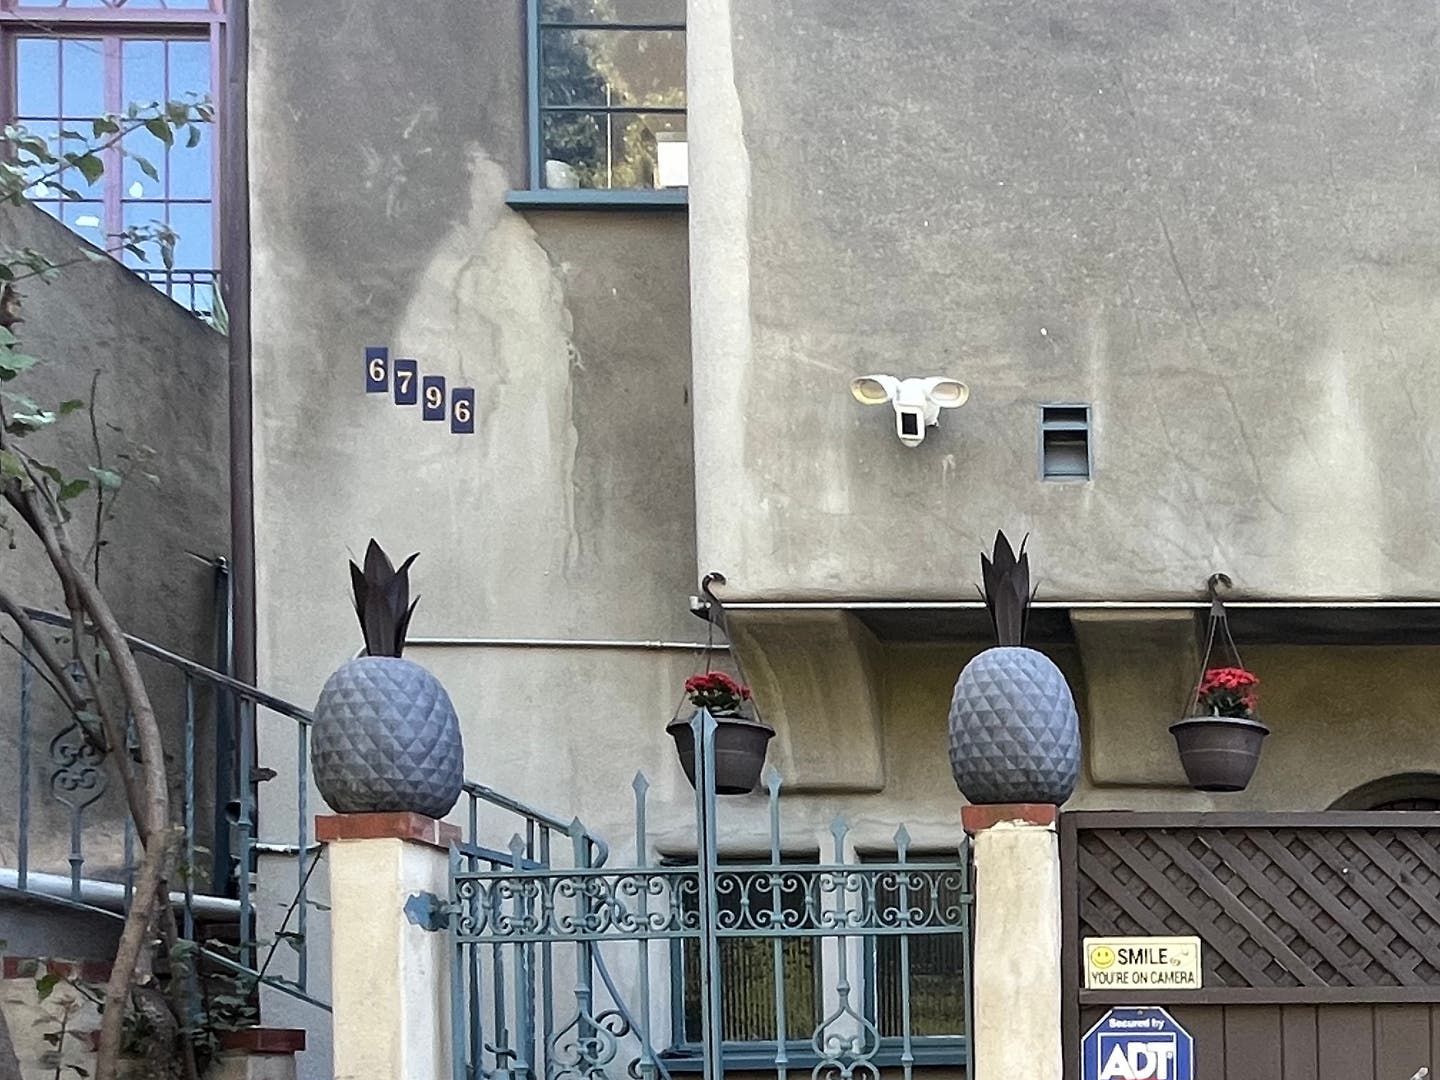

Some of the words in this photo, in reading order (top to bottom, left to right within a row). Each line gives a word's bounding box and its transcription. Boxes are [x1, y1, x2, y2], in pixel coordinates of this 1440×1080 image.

[369, 358, 471, 423] 6796
[1117, 948, 1168, 965] SMILE
[1091, 971, 1129, 985] YOU'RE
[1131, 971, 1148, 984] ON
[1150, 971, 1195, 985] CAMERA
[1109, 1018, 1150, 1029] Secured
[1151, 1018, 1165, 1030] by
[1101, 1042, 1174, 1080] ADT
